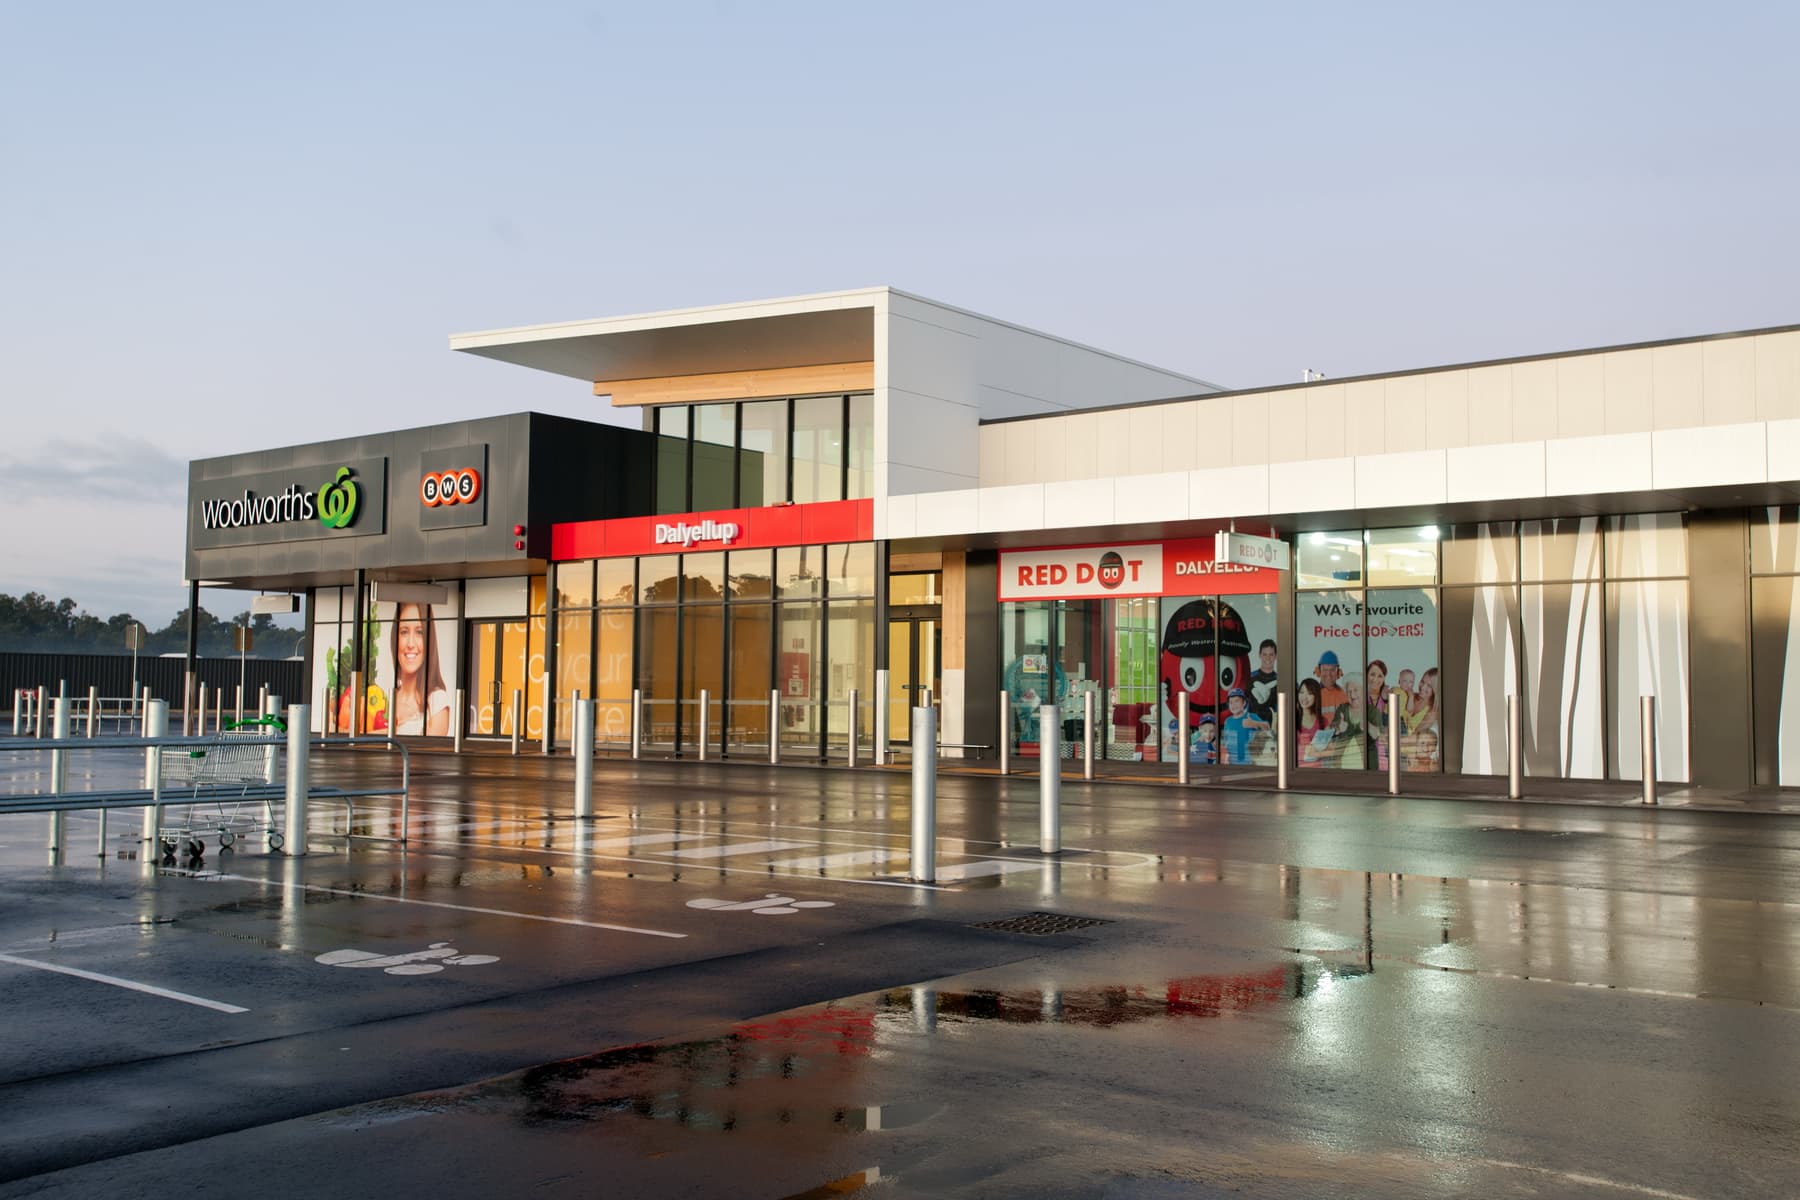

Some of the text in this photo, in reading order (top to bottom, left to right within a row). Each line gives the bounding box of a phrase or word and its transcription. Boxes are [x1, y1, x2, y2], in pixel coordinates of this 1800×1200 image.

[427, 479, 470, 497] BWS
[202, 483, 314, 529] Woolworths
[655, 519, 738, 547] Dalyellup
[1239, 544, 1256, 558] RED
[1017, 551, 1143, 590] RED DOT
[1176, 560, 1259, 575] DALYELL
[1314, 602, 1424, 616] WA's Favourite
[1177, 616, 1206, 632] RED
[1313, 623, 1424, 638] Price COPERS!
